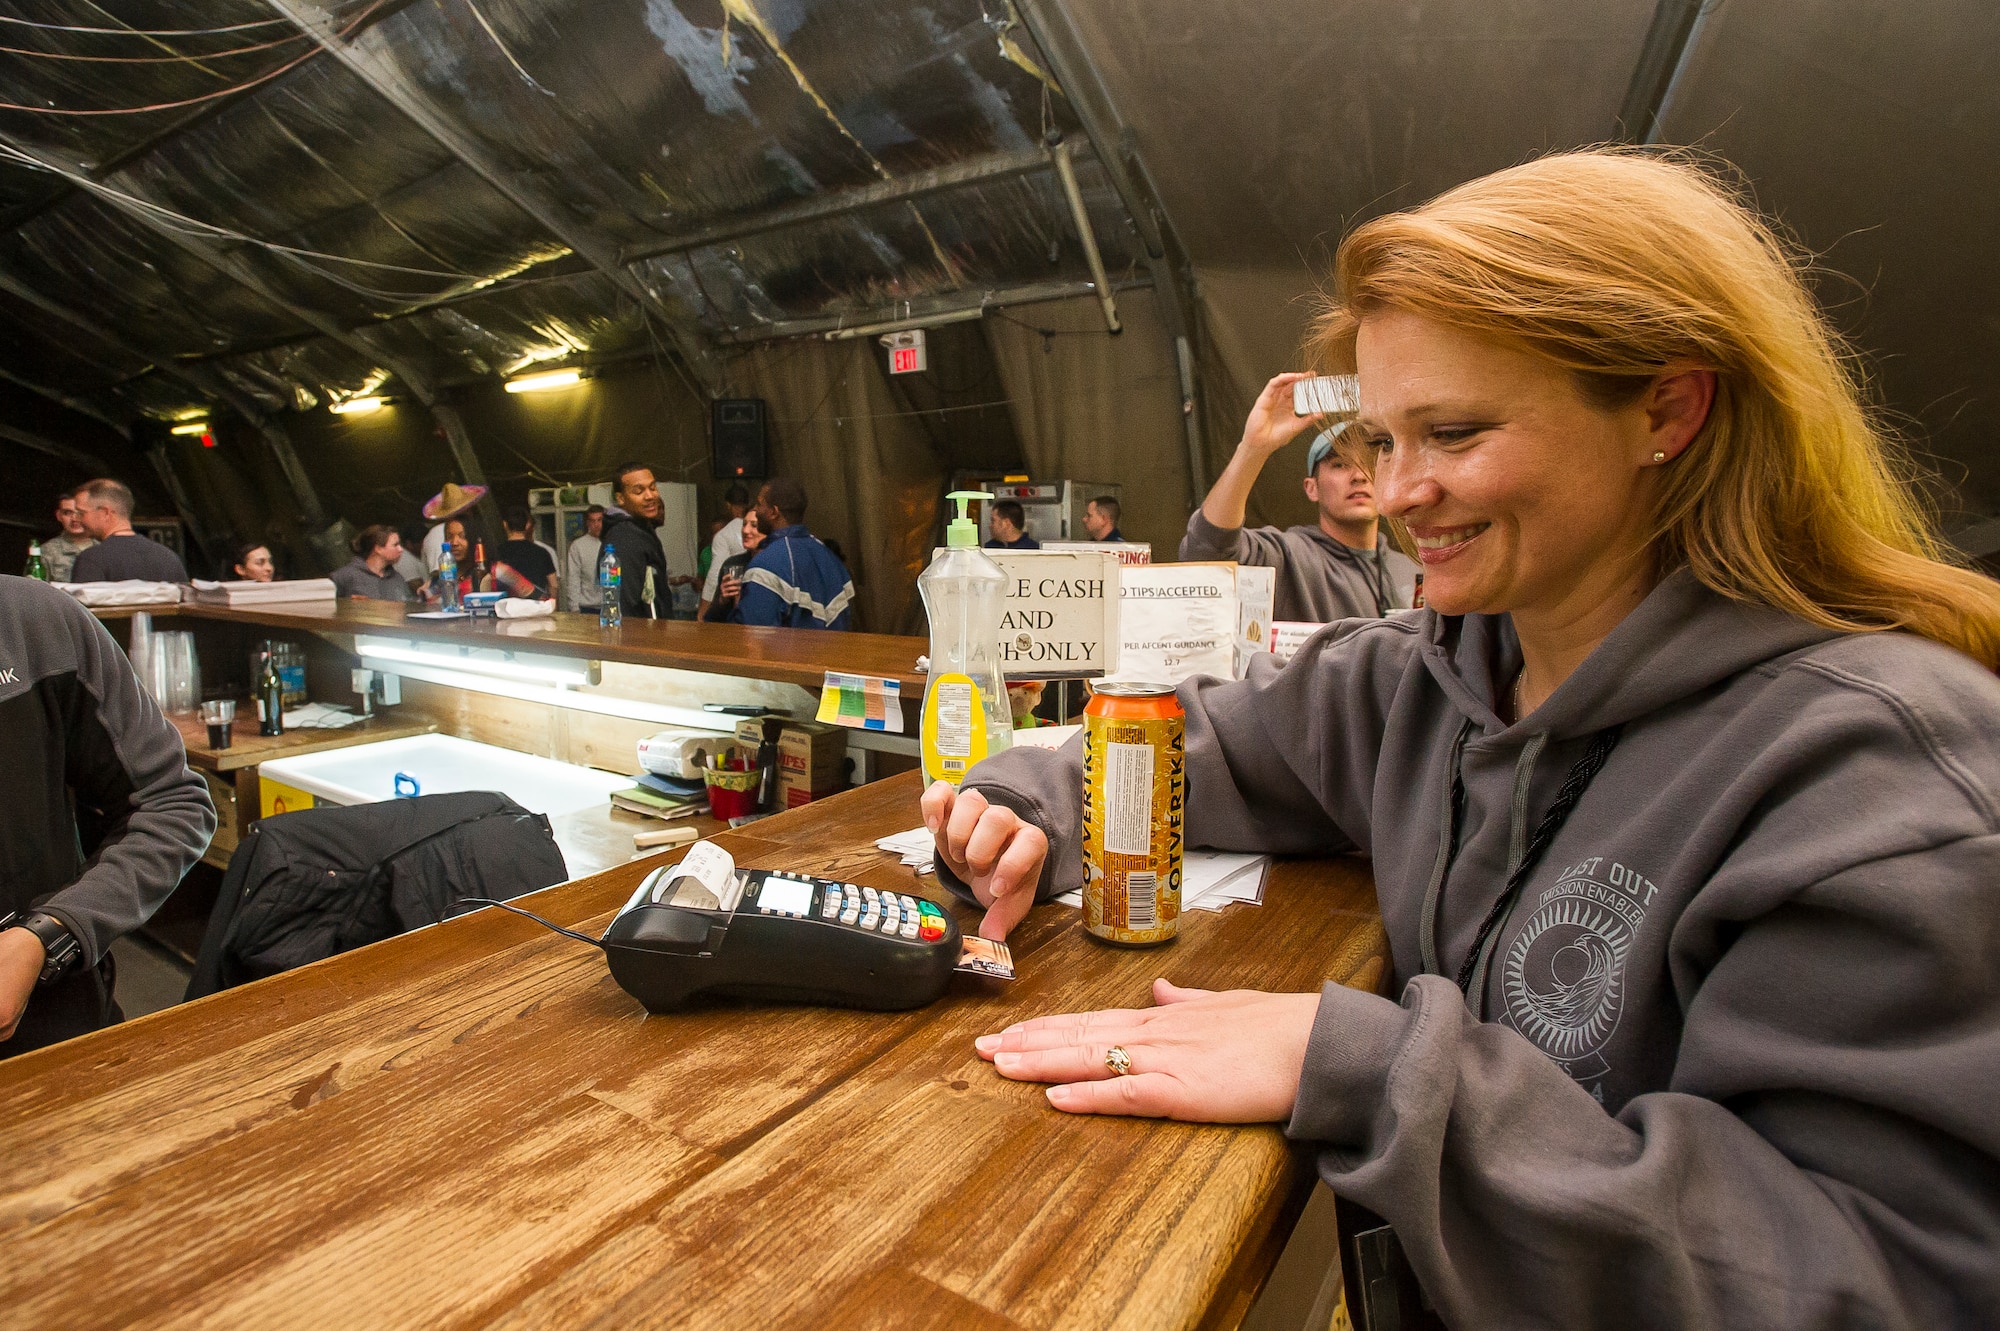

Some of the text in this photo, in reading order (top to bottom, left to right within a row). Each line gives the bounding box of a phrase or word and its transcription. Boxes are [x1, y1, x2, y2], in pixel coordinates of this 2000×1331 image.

[895, 349, 917, 371] EXIT
[1039, 579, 1104, 598] CASH
[1130, 586, 1155, 597] TIPS
[1158, 585, 1222, 596] ACCEPTED.
[999, 610, 1054, 629] AND
[1028, 641, 1098, 661] ONLY
[1124, 642, 1139, 650] PER
[1174, 640, 1217, 649] GUIDANCE
[1169, 731, 1182, 891] OTVERTKA
[1556, 856, 1658, 906] LAST OUT
[1542, 881, 1644, 931] MISSION ENABLER
